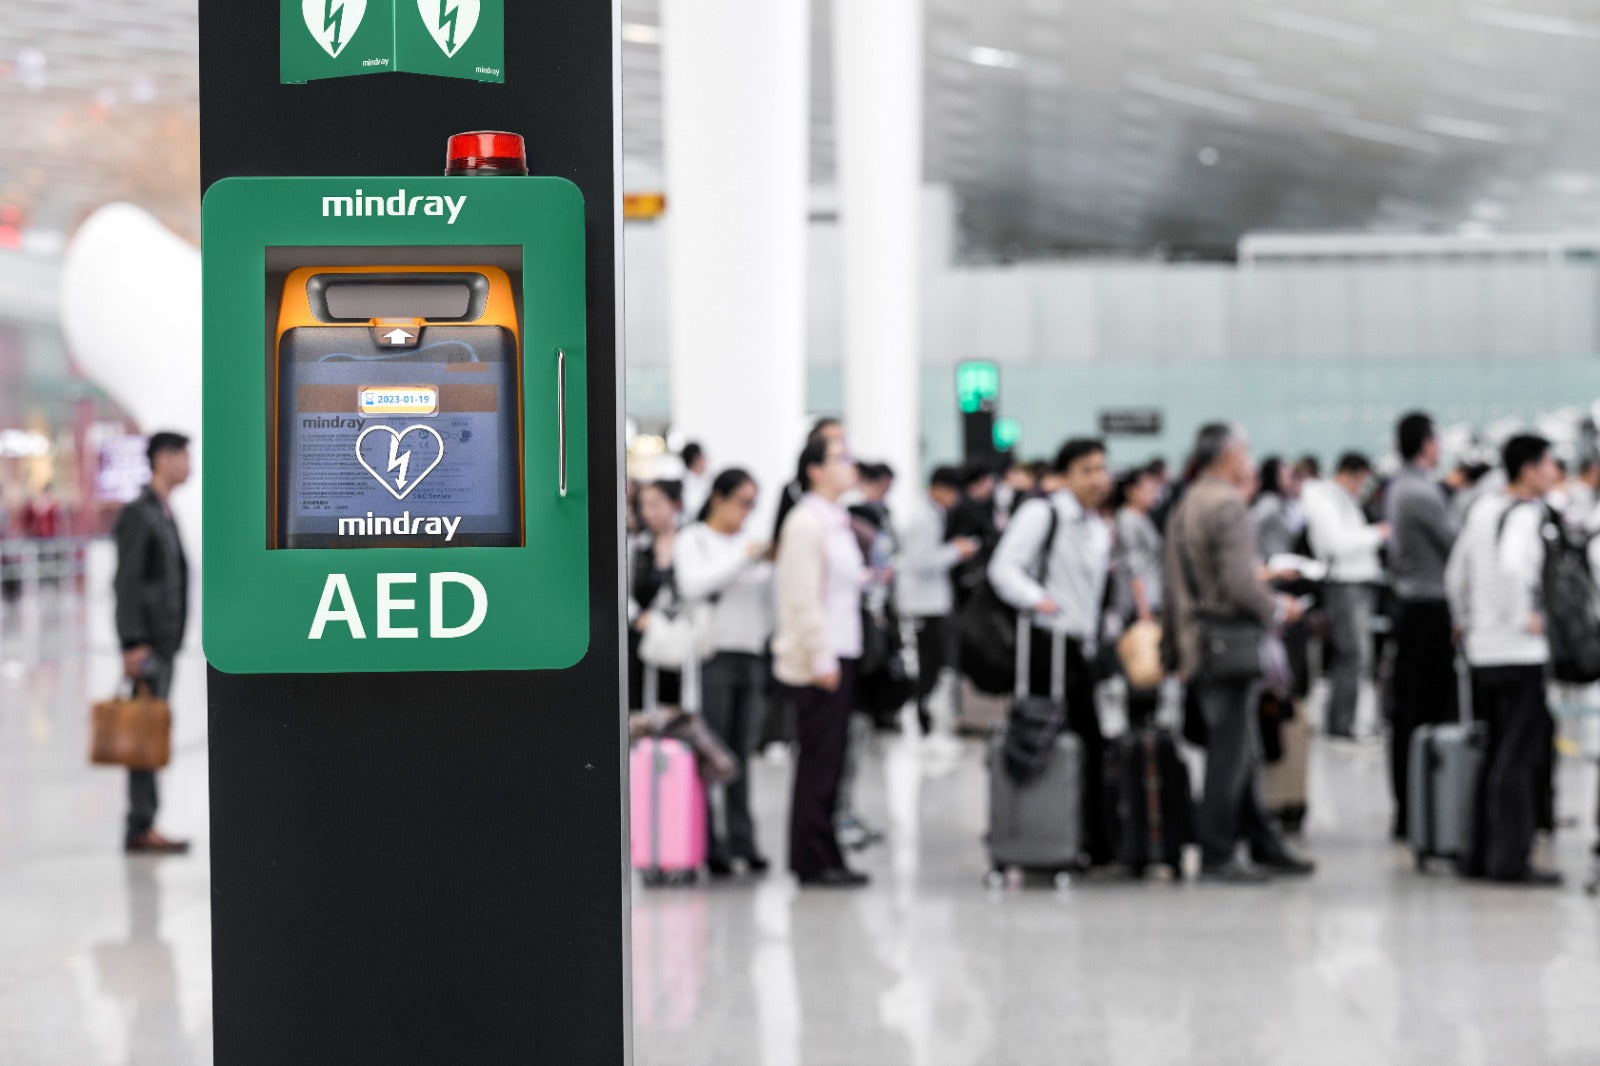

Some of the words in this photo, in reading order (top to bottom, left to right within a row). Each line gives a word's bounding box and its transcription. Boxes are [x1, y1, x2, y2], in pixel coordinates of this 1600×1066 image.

[362, 58, 389, 67] mindray
[322, 189, 467, 224] mindray
[377, 395, 430, 404] 2023-01-19
[302, 416, 366, 431] mindray
[338, 511, 462, 542] mindray
[307, 571, 489, 640] AED
